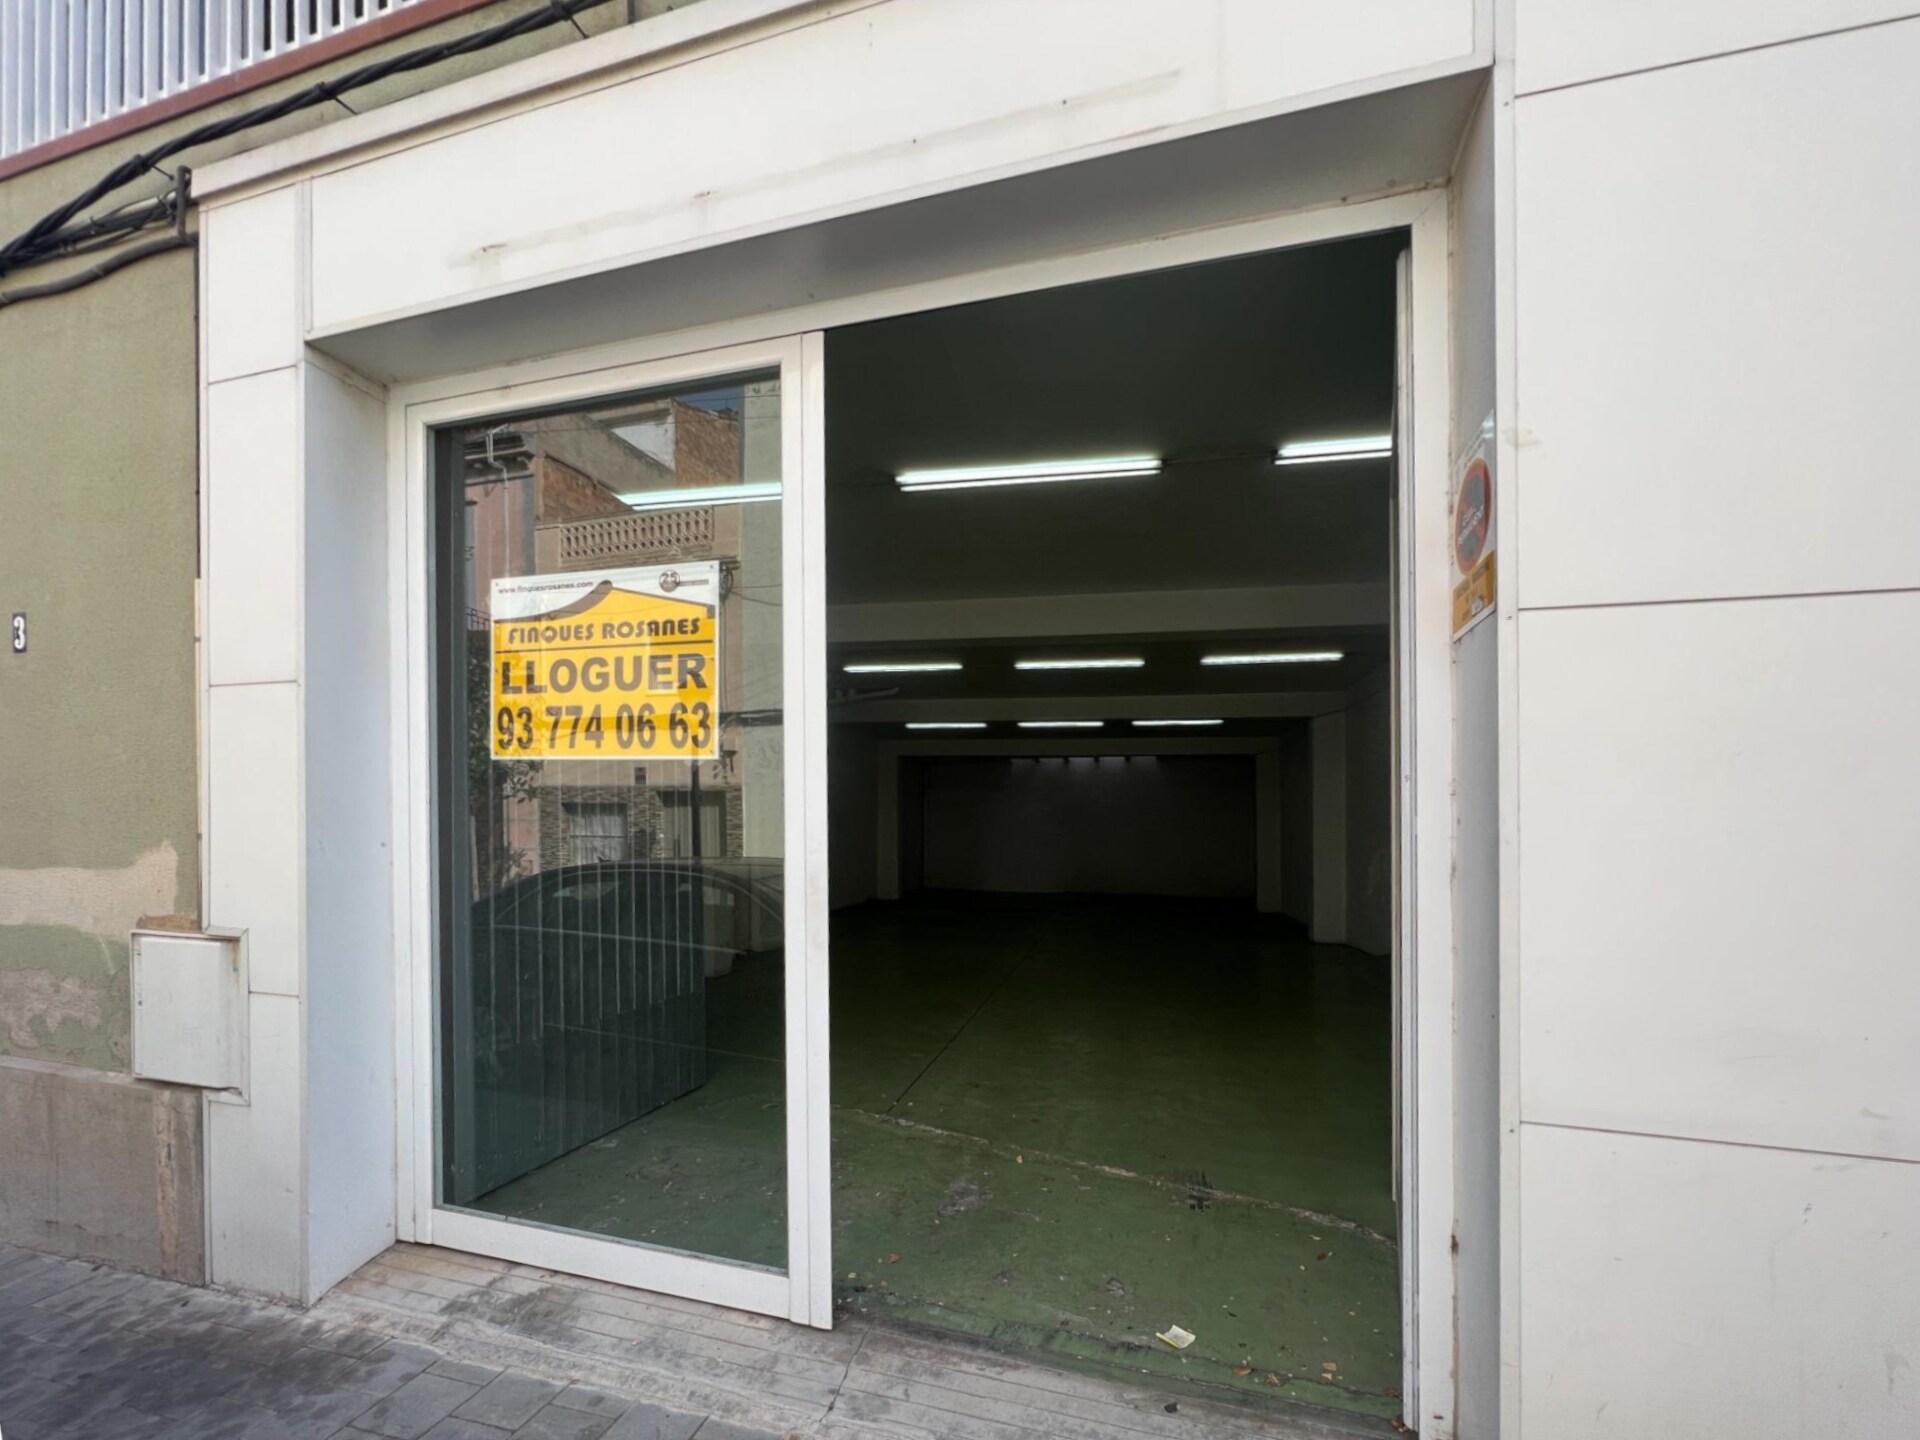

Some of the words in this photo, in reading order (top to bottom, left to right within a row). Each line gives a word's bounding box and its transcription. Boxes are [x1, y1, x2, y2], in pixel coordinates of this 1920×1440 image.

[13, 616, 25, 649] 3
[508, 623, 594, 644] FINQUES
[602, 617, 700, 639] ROSANES
[501, 654, 707, 694] LLOGUER
[497, 706, 534, 750] 93
[545, 704, 603, 748] 774
[616, 703, 656, 749] 06
[669, 701, 710, 748] 63
